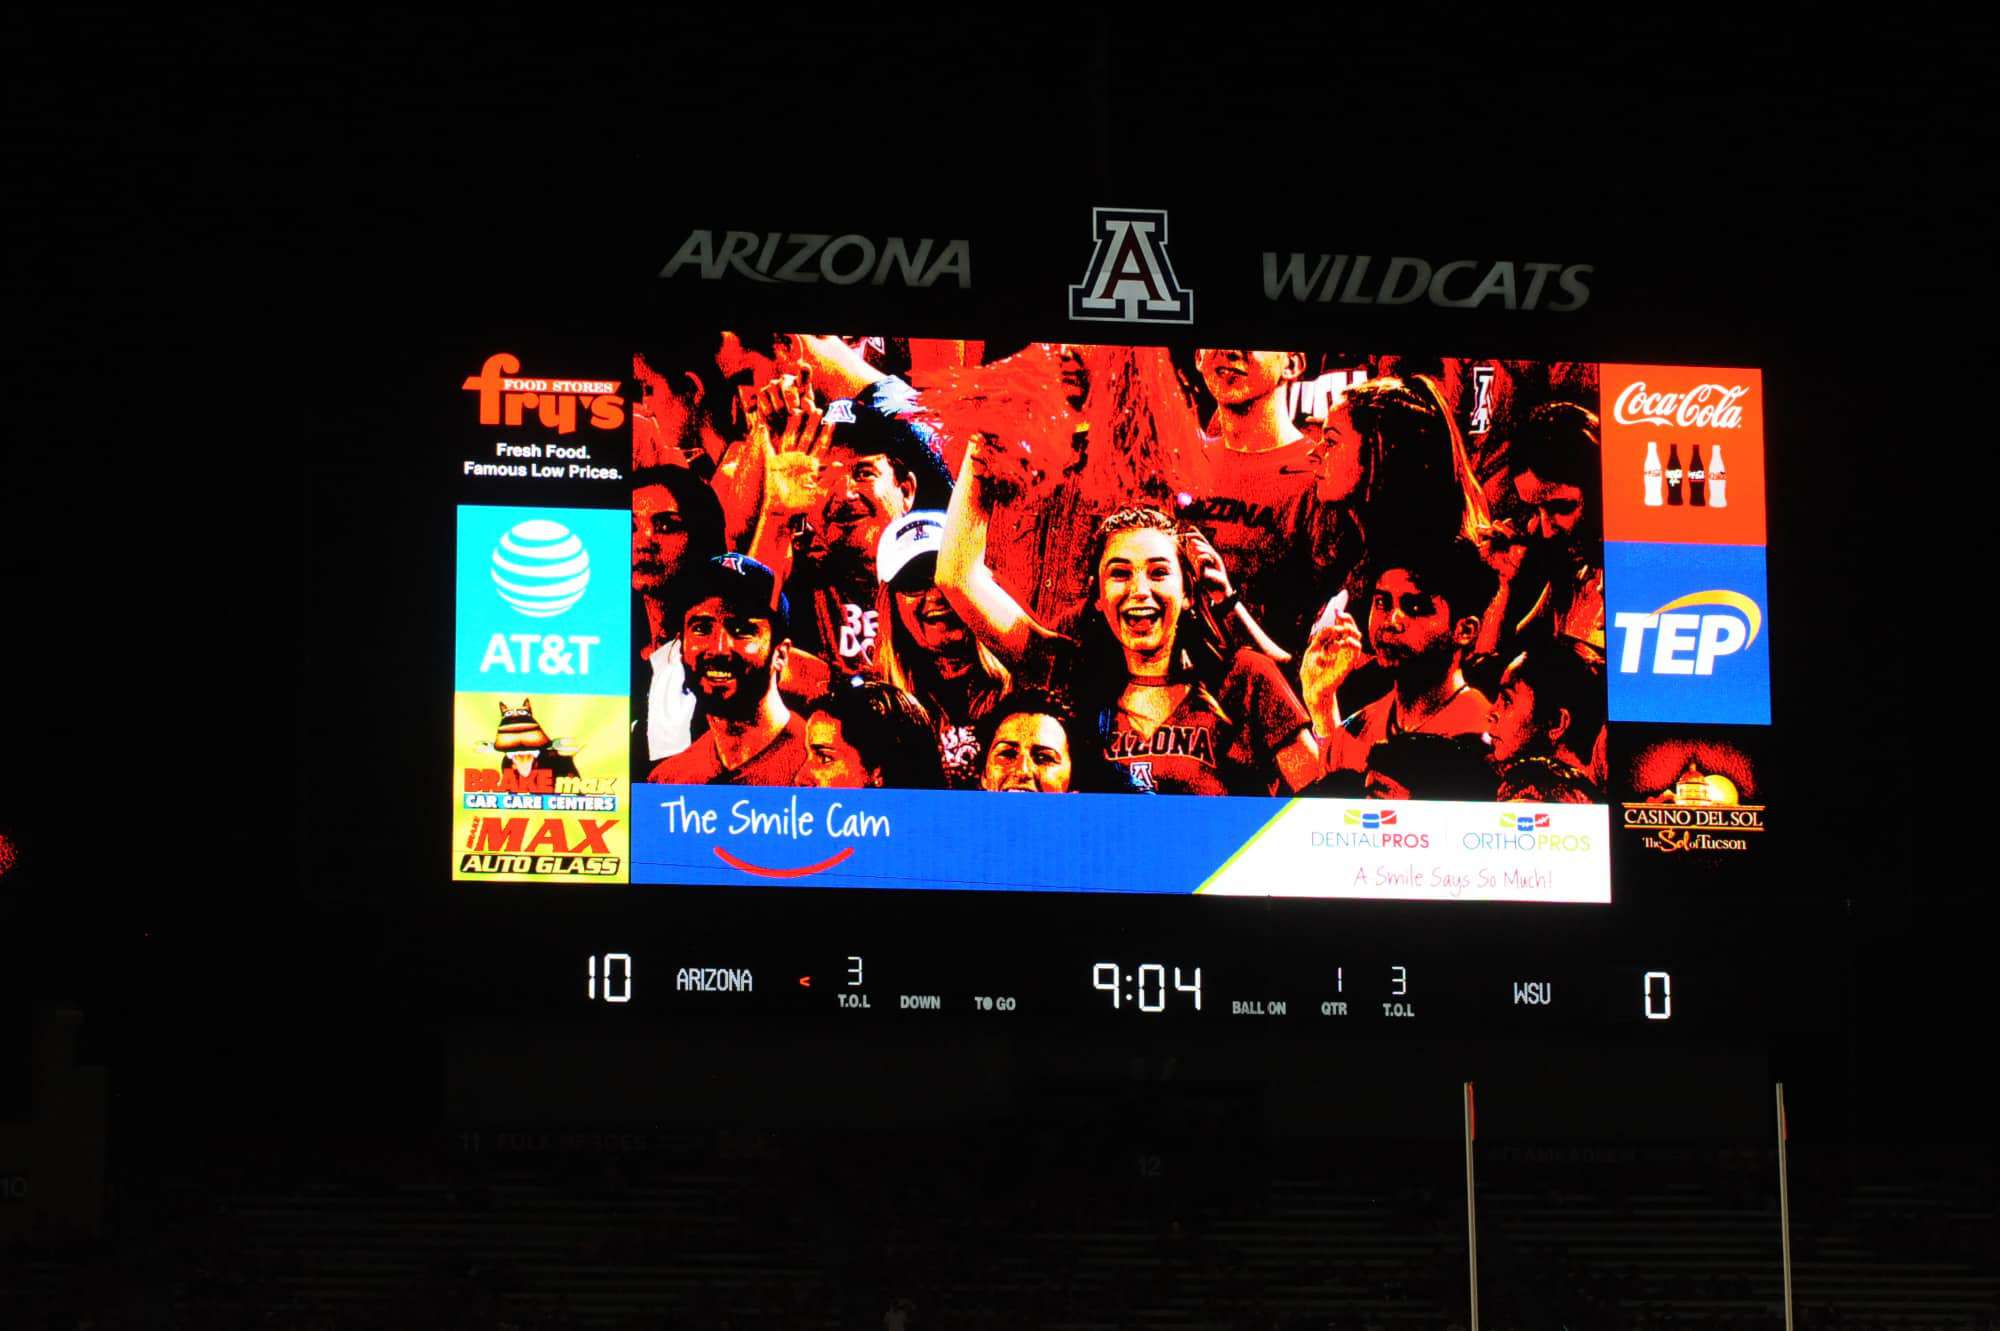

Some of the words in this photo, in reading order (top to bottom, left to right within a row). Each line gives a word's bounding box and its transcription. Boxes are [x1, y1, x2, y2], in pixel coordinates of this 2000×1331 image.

[657, 229, 973, 288] ARIZONA
[1068, 206, 1194, 325] A
[1261, 251, 1595, 311] WILDCATS
[462, 353, 625, 435] fry's
[503, 378, 548, 392] FOOD
[552, 380, 614, 393] STORES
[1613, 381, 1750, 429] Coca-Cola
[496, 442, 542, 458] Fresh
[545, 443, 591, 459] Food.
[463, 461, 527, 477] Famous
[531, 463, 565, 478] Low
[568, 464, 623, 480] Prices.
[479, 633, 600, 676] AT&T
[1614, 612, 1747, 676] TEP
[465, 794, 498, 809] CAR
[502, 795, 543, 810] CARE
[547, 796, 615, 811] CENTERS
[661, 795, 718, 834] The
[728, 795, 814, 839] Smile
[826, 802, 890, 838] Cam
[1624, 809, 1691, 825] CASINO
[1695, 811, 1728, 825] DEL
[1730, 811, 1764, 827] SOL
[474, 817, 621, 854] MAX
[1641, 836, 1662, 849] The
[1658, 828, 1690, 852] Sol
[1697, 834, 1748, 850] Tucson
[462, 856, 531, 873] AUTO
[535, 857, 620, 875] GLASS
[1353, 866, 1368, 887] A
[1375, 864, 1424, 888] Smile
[1430, 866, 1471, 898] Says
[1477, 868, 1497, 889] So
[1503, 867, 1552, 889] Much!
[588, 953, 632, 1003] 10
[676, 967, 753, 992] ARIZONA
[847, 955, 863, 987] 3
[1337, 966, 1343, 993] 1
[1391, 965, 1407, 996] 3
[899, 995, 941, 1010] DOWN
[1093, 963, 1202, 1013] 9:04
[1513, 981, 1551, 1005] WSU
[1644, 971, 1672, 1020] 0
[974, 996, 994, 1011] TO
[995, 997, 1017, 1012] GO
[1231, 1001, 1265, 1016] BALL
[1267, 1001, 1287, 1016] ON
[1320, 1002, 1348, 1016] QTR
